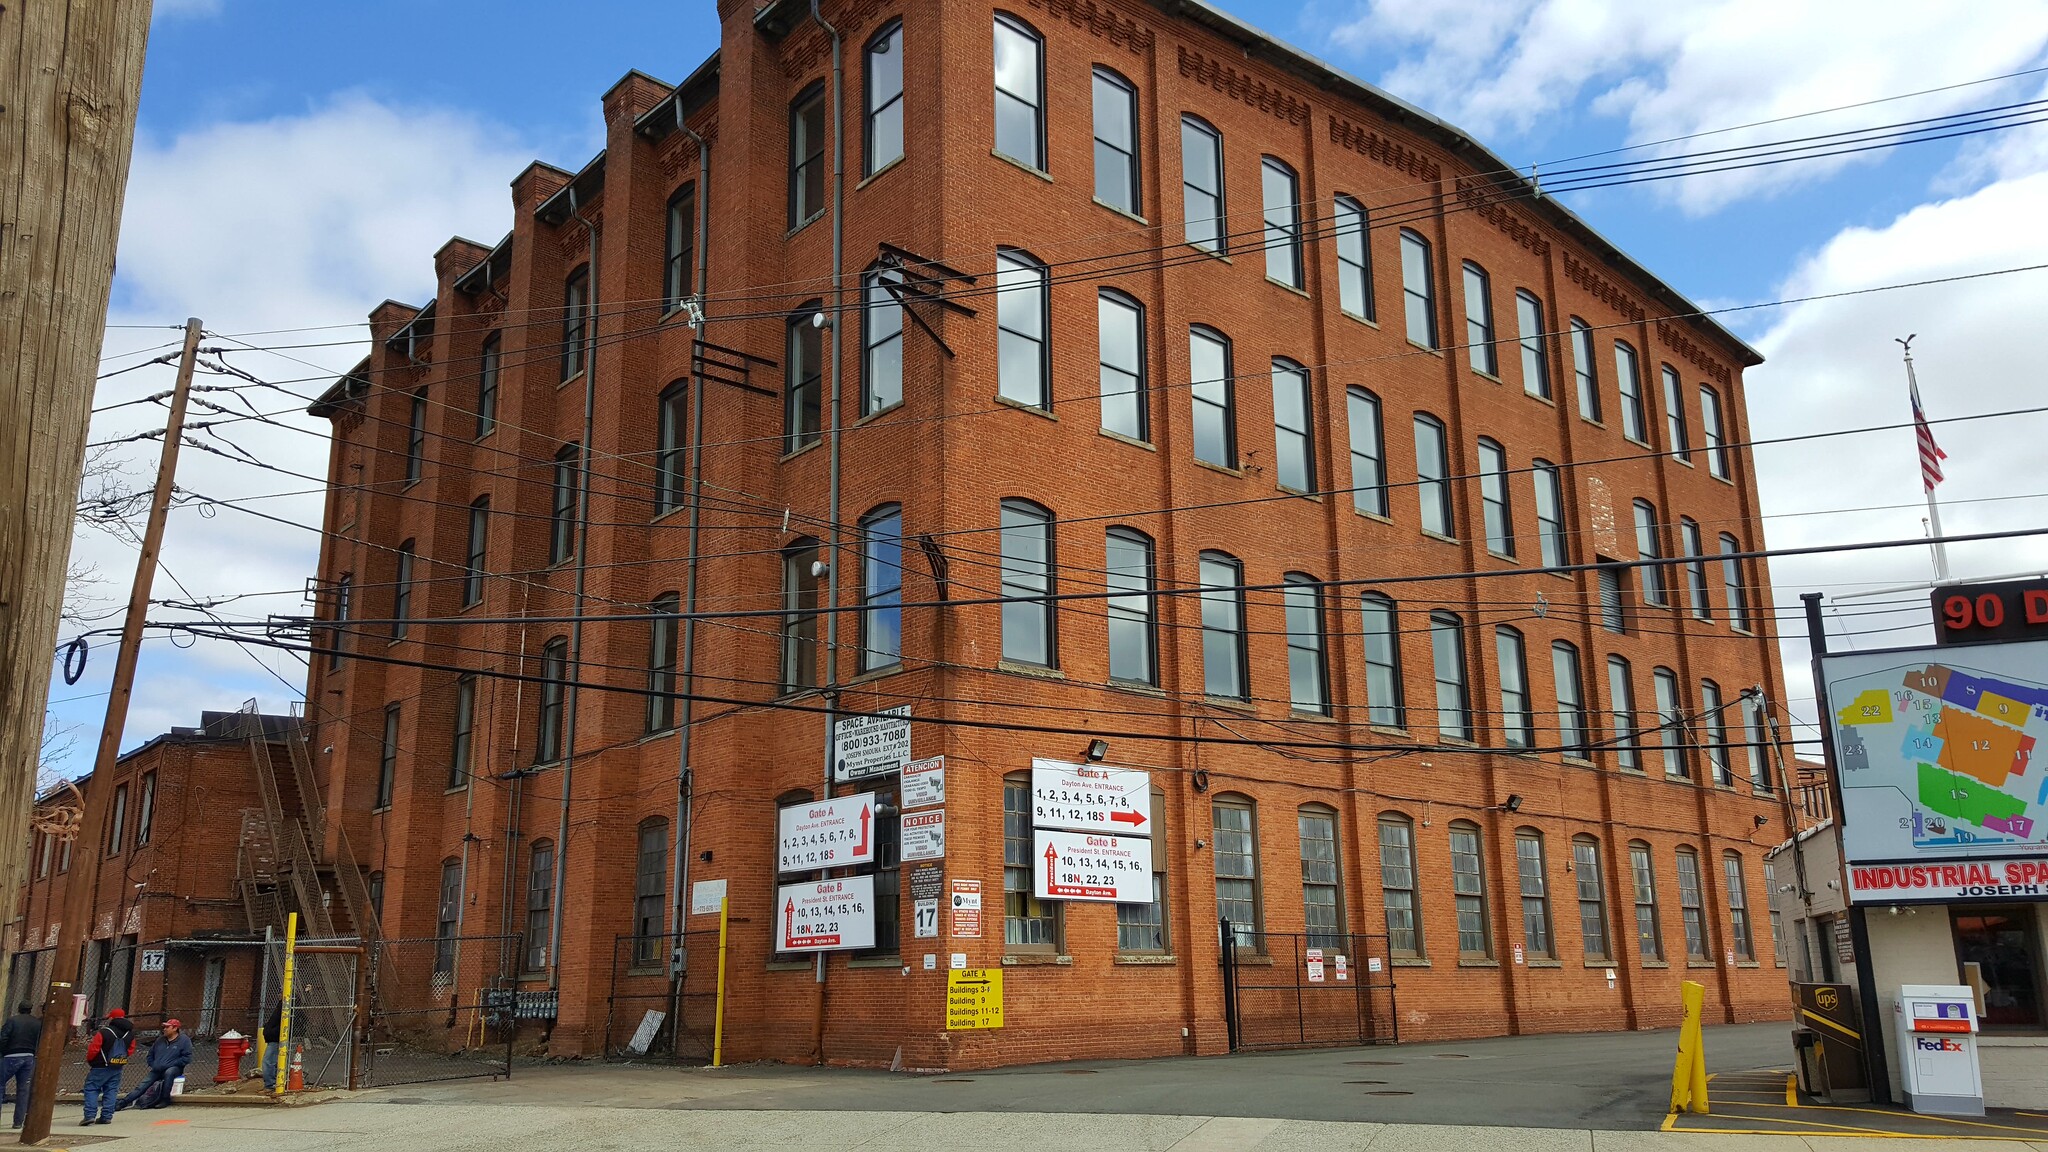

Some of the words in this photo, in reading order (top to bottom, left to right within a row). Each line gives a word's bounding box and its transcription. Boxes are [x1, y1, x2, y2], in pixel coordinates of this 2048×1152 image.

[1944, 593, 2004, 629] 90
[2023, 589, 2048, 624] D
[1920, 677, 1938, 687] 10
[1895, 690, 1913, 701] 16
[1913, 699, 1932, 710] 15
[1998, 704, 2008, 714] 9
[1862, 706, 1880, 716] 22
[842, 717, 863, 730] SPACE
[1923, 713, 1942, 724] 13
[836, 731, 852, 741] OFFICE
[842, 729, 905, 751] (800)933-7080
[1913, 738, 1932, 749] 14
[1972, 740, 1990, 750] 12
[845, 751, 861, 759] JOSEPH
[1845, 745, 1863, 755] 23
[2016, 750, 2032, 760] 11
[864, 754, 891, 764] Properties
[893, 750, 908, 758] L.L.C.
[869, 762, 898, 772] Management
[906, 761, 939, 773] ATENCION
[1078, 768, 1099, 778] Gate
[1095, 783, 1123, 791] ENTRANCE
[908, 796, 936, 804] SURVEILLANCE
[809, 808, 826, 818] Gate
[828, 806, 834, 815] A
[821, 818, 844, 827] ENTRANCE
[905, 815, 940, 826] NOTICE
[1899, 818, 1916, 828] 21
[1925, 818, 1944, 828] 20
[2007, 820, 2024, 831] 17
[1086, 836, 1108, 846] Gate
[1111, 839, 1117, 847] B
[1955, 832, 1973, 843] 19
[1102, 849, 1131, 857] ENTRANCE
[1851, 864, 2000, 890] INDUSTRIAL
[817, 885, 834, 894] Gate
[837, 882, 842, 891] B
[1957, 885, 2038, 896] JOSEPH
[829, 893, 854, 902] ENTRANCE
[963, 897, 978, 905] Mynt
[917, 908, 935, 927] 17
[144, 955, 163, 965] 17
[950, 986, 978, 994] Buildings
[1818, 995, 1836, 1007] ups
[950, 1008, 979, 1016] Buildings
[1917, 1037, 1962, 1052] FedEx
